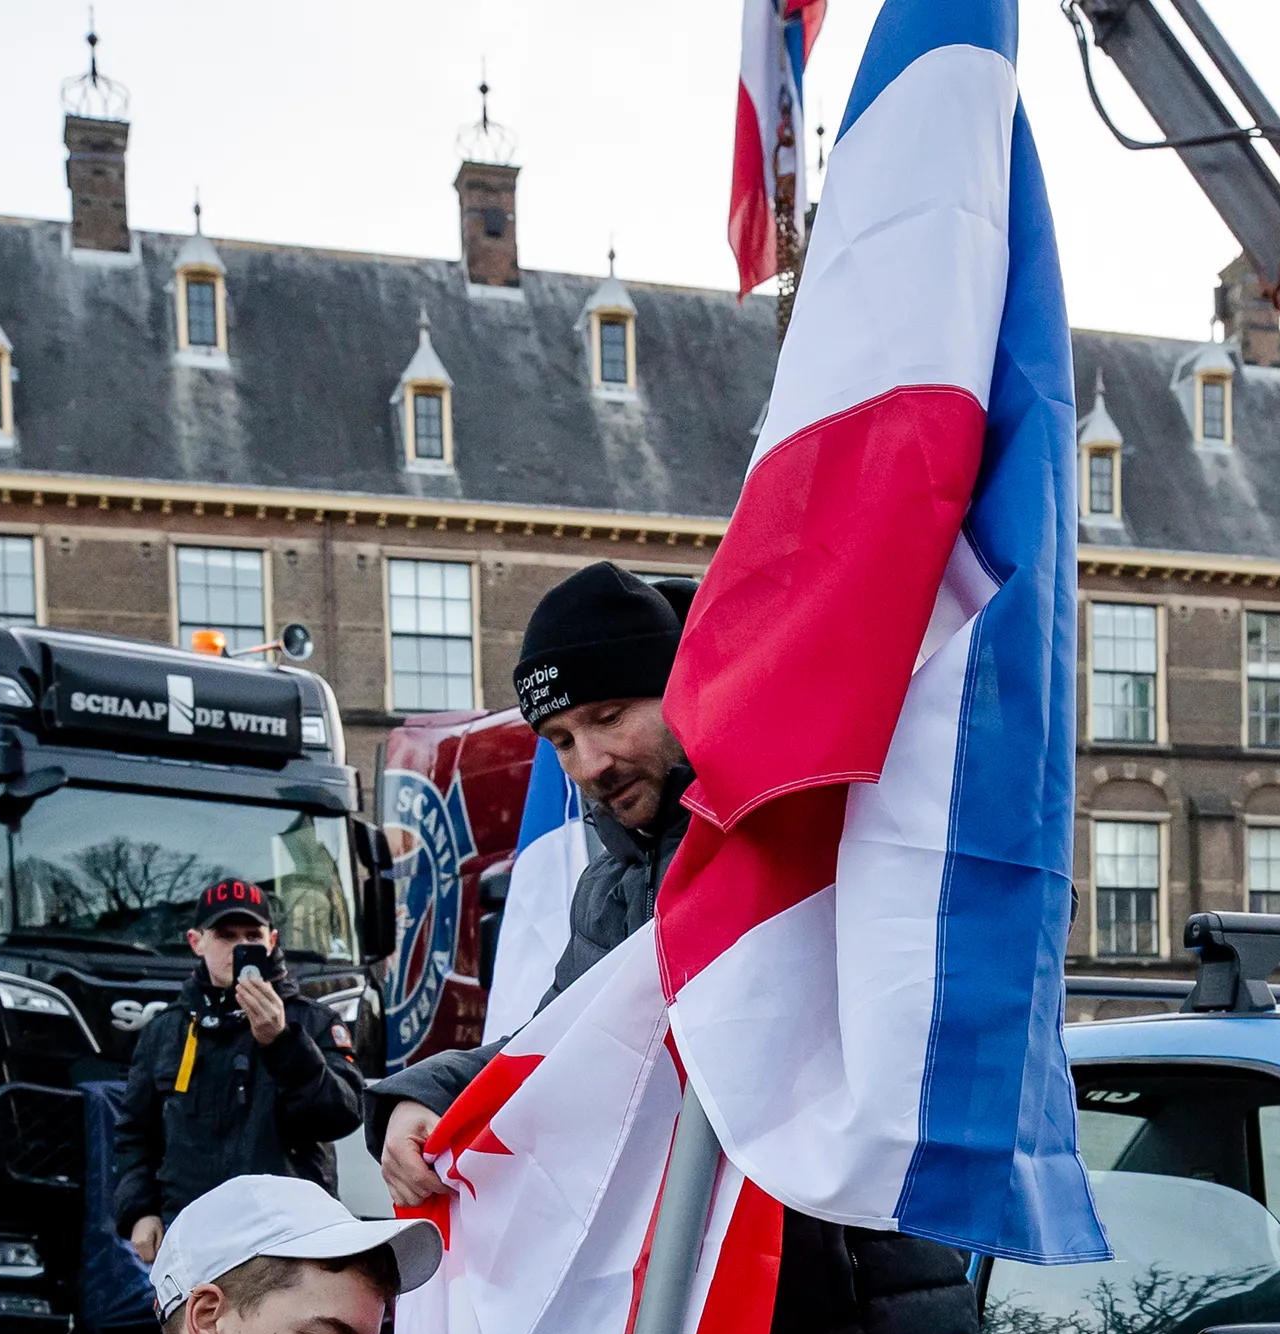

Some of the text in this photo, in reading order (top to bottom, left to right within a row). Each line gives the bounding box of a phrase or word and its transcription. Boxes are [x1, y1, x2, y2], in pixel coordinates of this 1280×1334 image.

[70, 691, 288, 737] SCHAAP DE WITH
[396, 786, 454, 897] SCANIA
[206, 883, 262, 906] ICON
